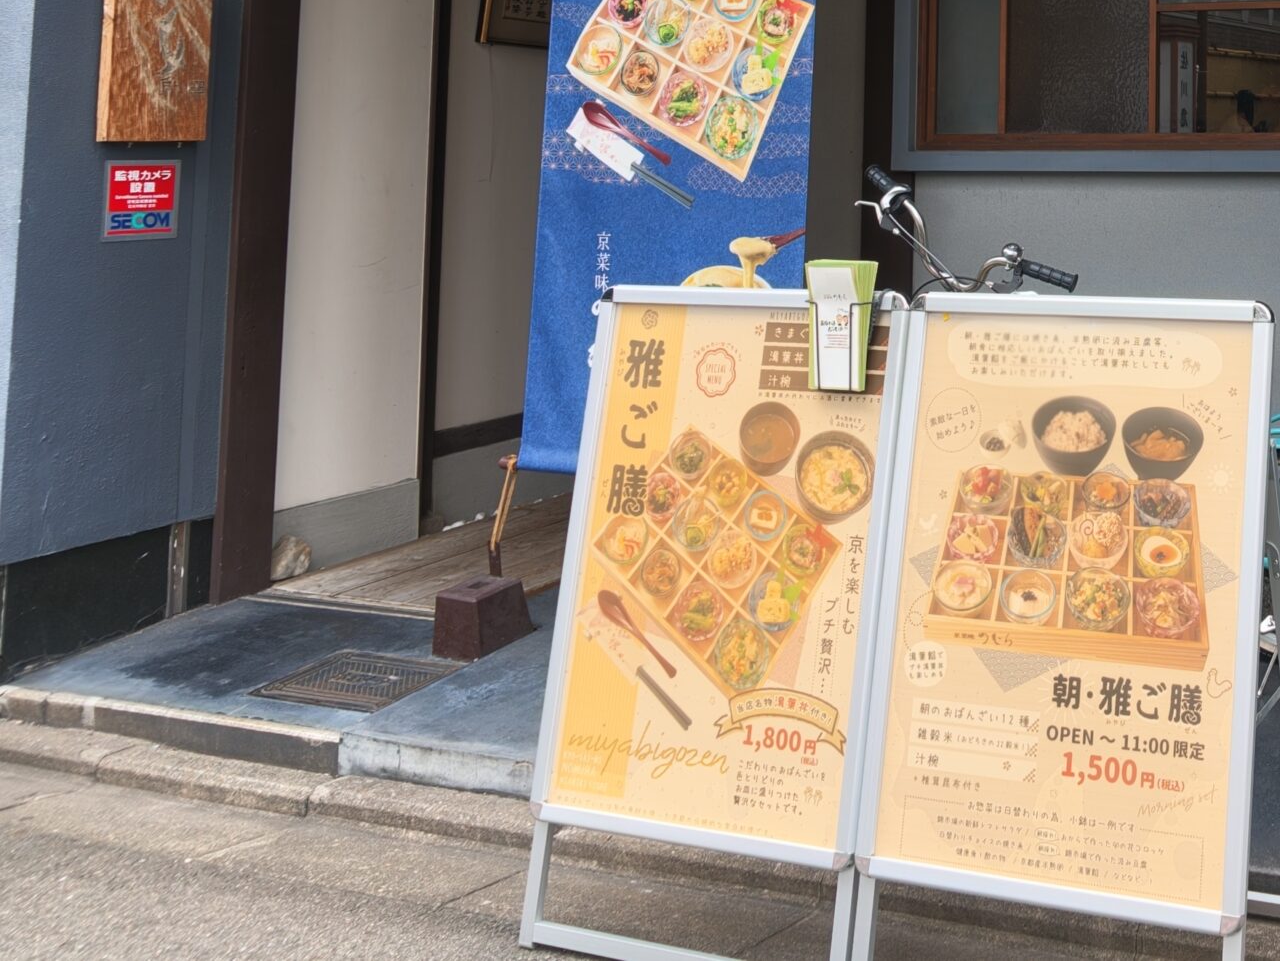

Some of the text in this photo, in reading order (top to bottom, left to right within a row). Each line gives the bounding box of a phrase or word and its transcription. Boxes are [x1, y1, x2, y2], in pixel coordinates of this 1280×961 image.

[114, 170, 171, 181] 監視カメラ
[130, 182, 155, 193] 設置
[111, 212, 170, 229] SECOM
[606, 338, 665, 517] 雅ご膳
[842, 534, 864, 635] 京を楽しむ
[1046, 725, 1094, 746] OPEN
[1121, 734, 1169, 755] 11:00
